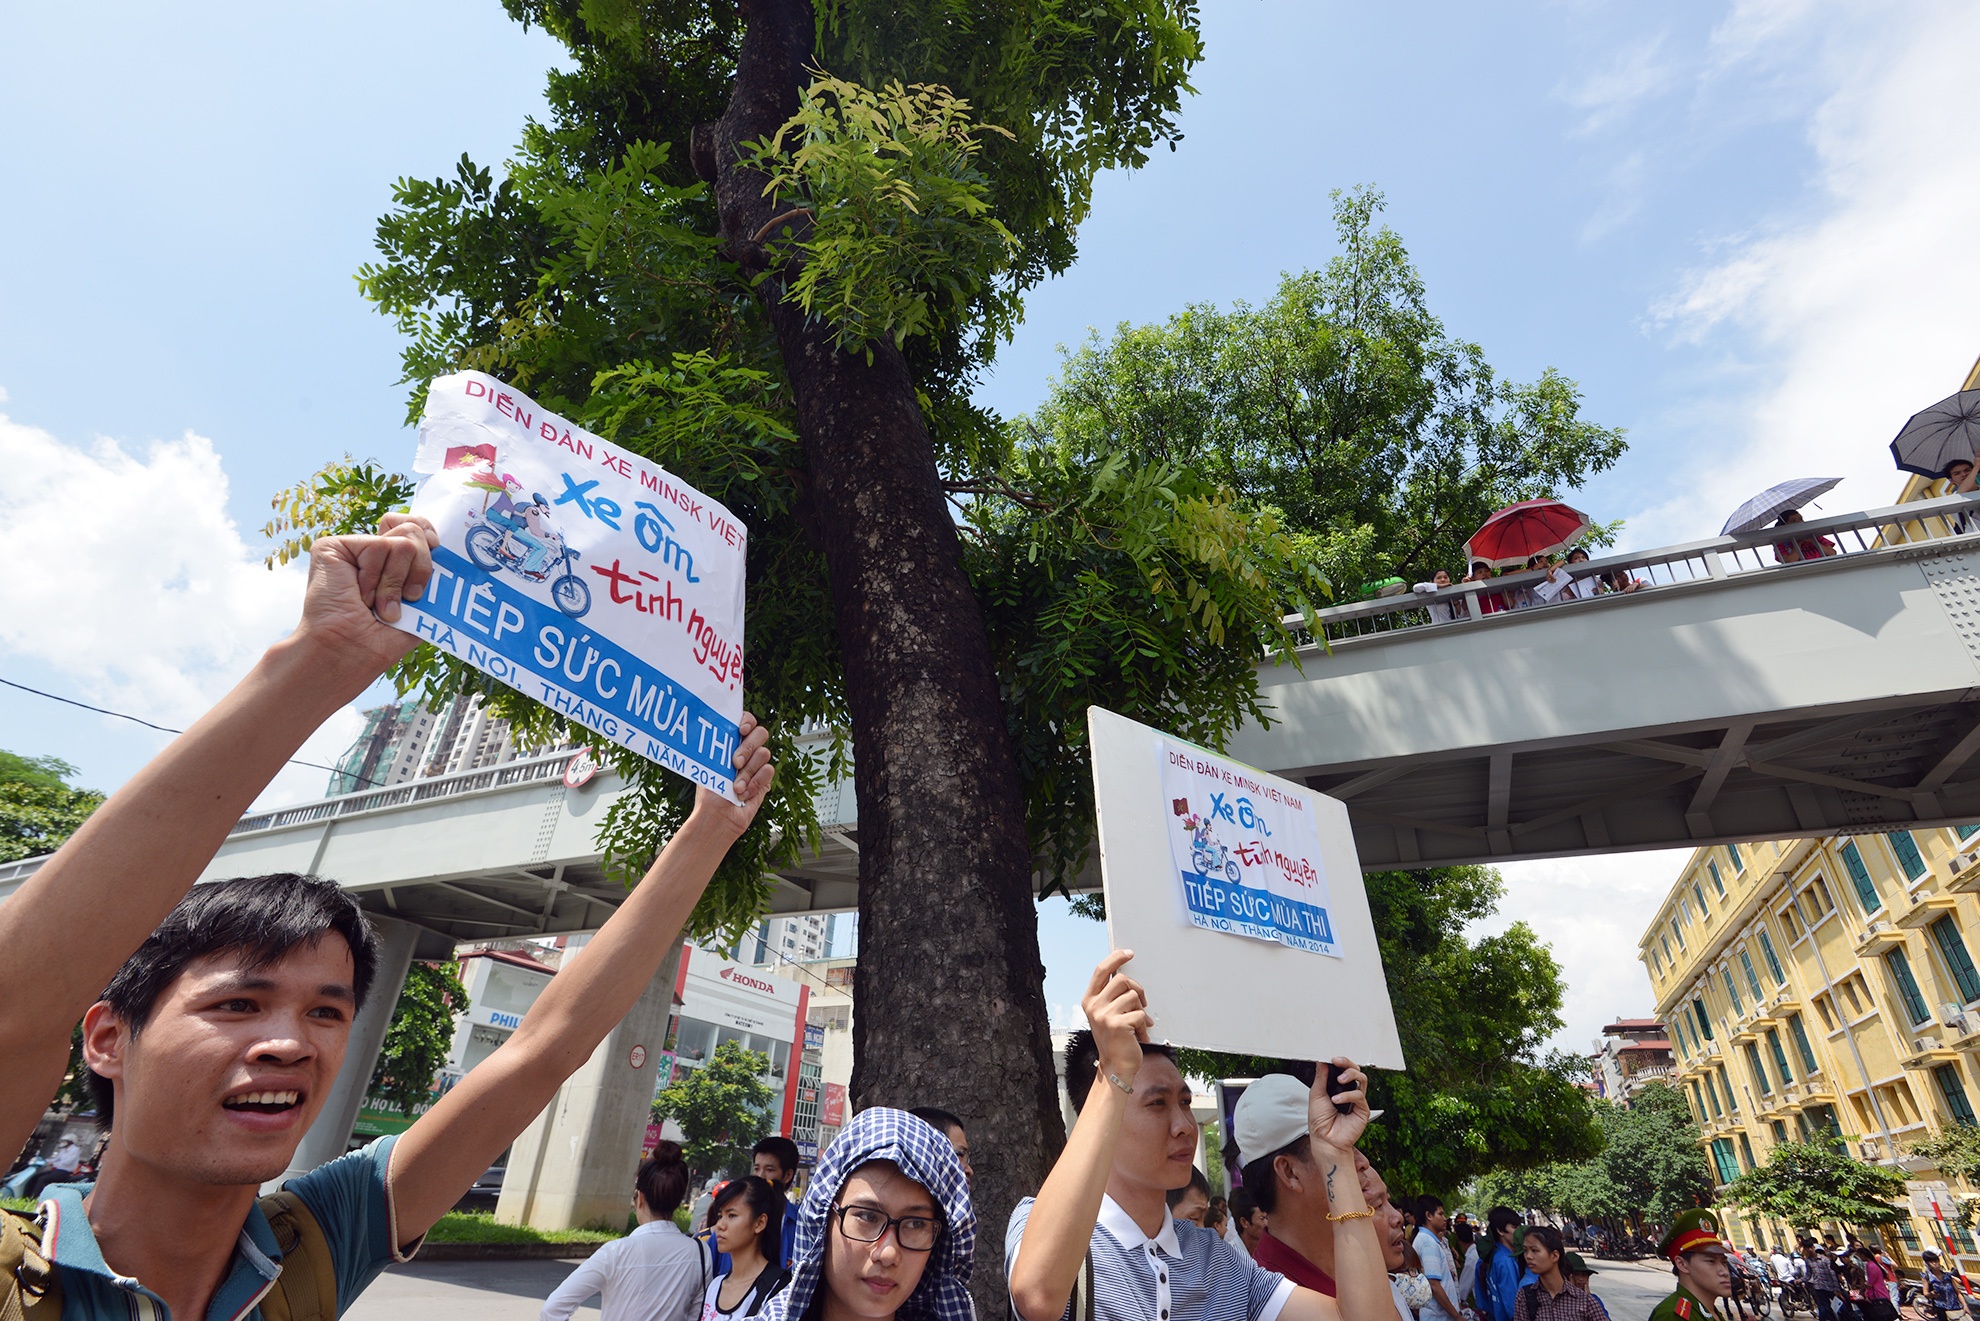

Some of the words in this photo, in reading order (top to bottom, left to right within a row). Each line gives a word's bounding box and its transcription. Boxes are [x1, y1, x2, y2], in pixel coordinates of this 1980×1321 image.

[465, 380, 532, 430] DIỄN
[540, 421, 593, 460] ĐÀN
[601, 450, 633, 479] XE
[640, 470, 703, 522] MINSK
[709, 511, 745, 551] VIỆT
[553, 472, 622, 531] Xe
[427, 568, 525, 641] TIẾP
[533, 625, 621, 699] SỨC
[626, 674, 688, 745] MÙA
[697, 715, 735, 770] THI
[415, 615, 458, 652] HÀ
[540, 682, 618, 737] THÁNG
[625, 728, 636, 744] 7
[646, 740, 685, 773] NĂM
[690, 765, 726, 794] 2014
[1169, 751, 1194, 772] DIỄN
[1196, 761, 1219, 779] ĐÀN
[1221, 769, 1233, 785] XE
[1233, 775, 1261, 796] MINSK
[1262, 785, 1282, 804] VIỆT
[1284, 795, 1303, 811] NAM
[1210, 792, 1236, 825] Xe
[1275, 850, 1319, 888] nguyện
[1185, 881, 1225, 911] TIẾP
[1230, 890, 1271, 921] SỨC
[1270, 901, 1303, 931] MÙA
[1302, 910, 1327, 937] THI
[1194, 914, 1209, 927] HÀ
[1286, 936, 1307, 949] NĂM
[1308, 941, 1330, 954] 2014
[732, 972, 775, 994] HONDA
[489, 1012, 524, 1029] PHIL
